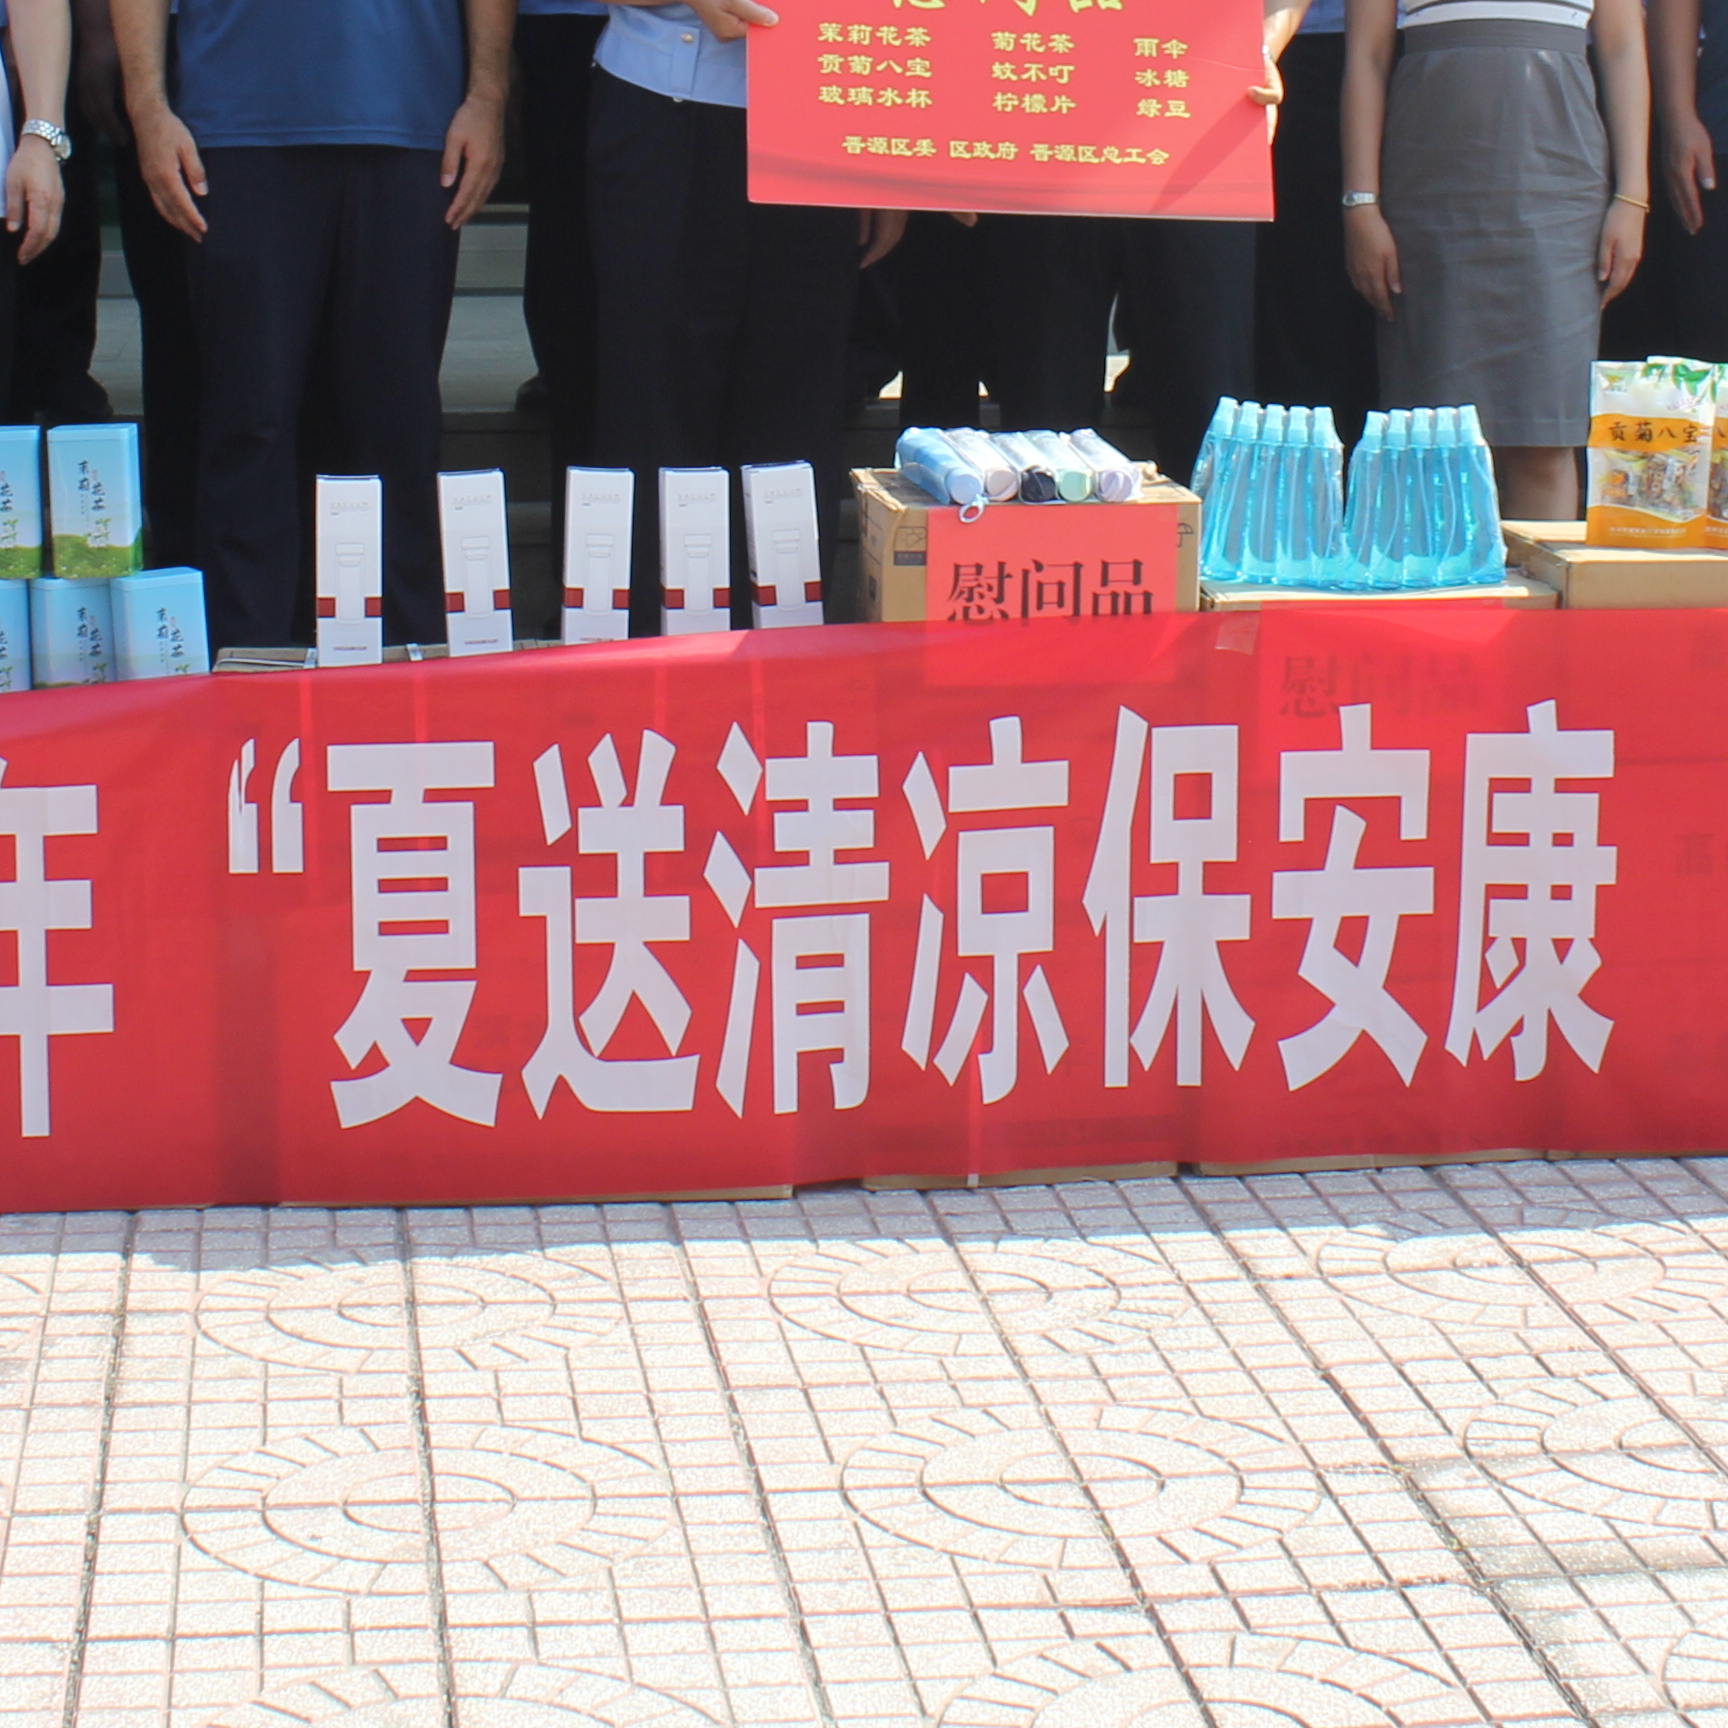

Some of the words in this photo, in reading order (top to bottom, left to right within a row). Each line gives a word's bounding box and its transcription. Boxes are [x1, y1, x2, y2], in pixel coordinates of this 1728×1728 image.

[818, 22, 932, 48] 茉莉花茶
[991, 32, 1075, 54] 菊花茶
[1134, 37, 1188, 60] 雨伞
[818, 54, 933, 79] 贡菊八宝
[991, 61, 1075, 86] 蚊不叮
[1135, 68, 1189, 90] 冰糖
[818, 85, 933, 110] 玻璃水杯
[993, 91, 1076, 116] 柠檬片
[1136, 98, 1191, 120] 绿豆
[842, 135, 937, 158] 晋源区委
[949, 140, 1019, 162] 区政府
[1029, 144, 1170, 167] 晋源区总工会
[1608, 421, 1698, 443] 贡菊八宝
[947, 558, 1154, 623] 慰问品
[227, 699, 1617, 1129] “夏送清凉保安康
